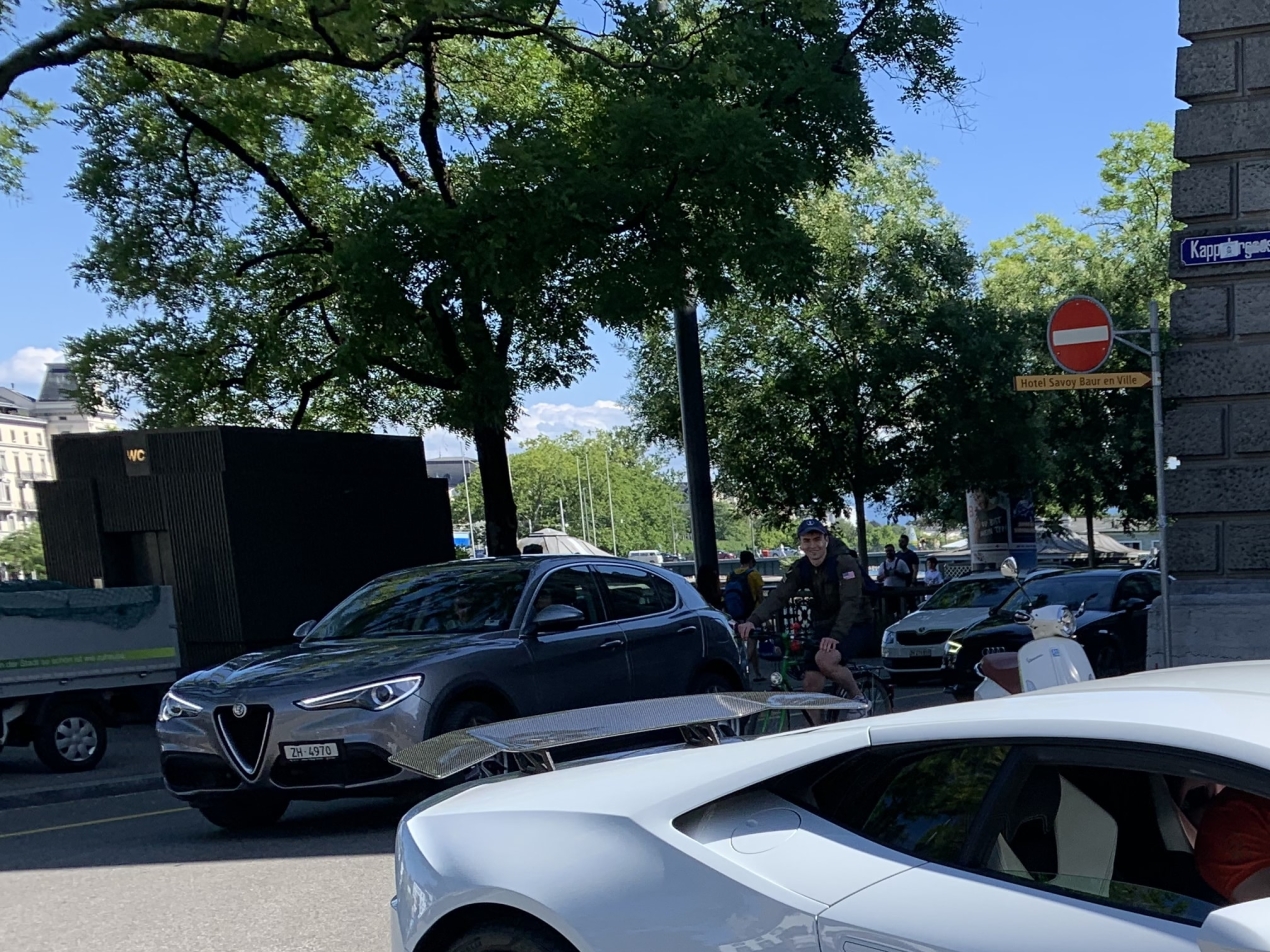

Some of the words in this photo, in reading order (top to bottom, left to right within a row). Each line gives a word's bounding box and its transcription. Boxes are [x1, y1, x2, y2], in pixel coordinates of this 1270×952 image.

[1021, 378, 1046, 388] Hotel
[1049, 377, 1077, 388] Savoy
[1080, 376, 1100, 386] Baur
[1104, 378, 1115, 386] en
[1117, 375, 1137, 385] Ville
[126, 449, 146, 461] WC
